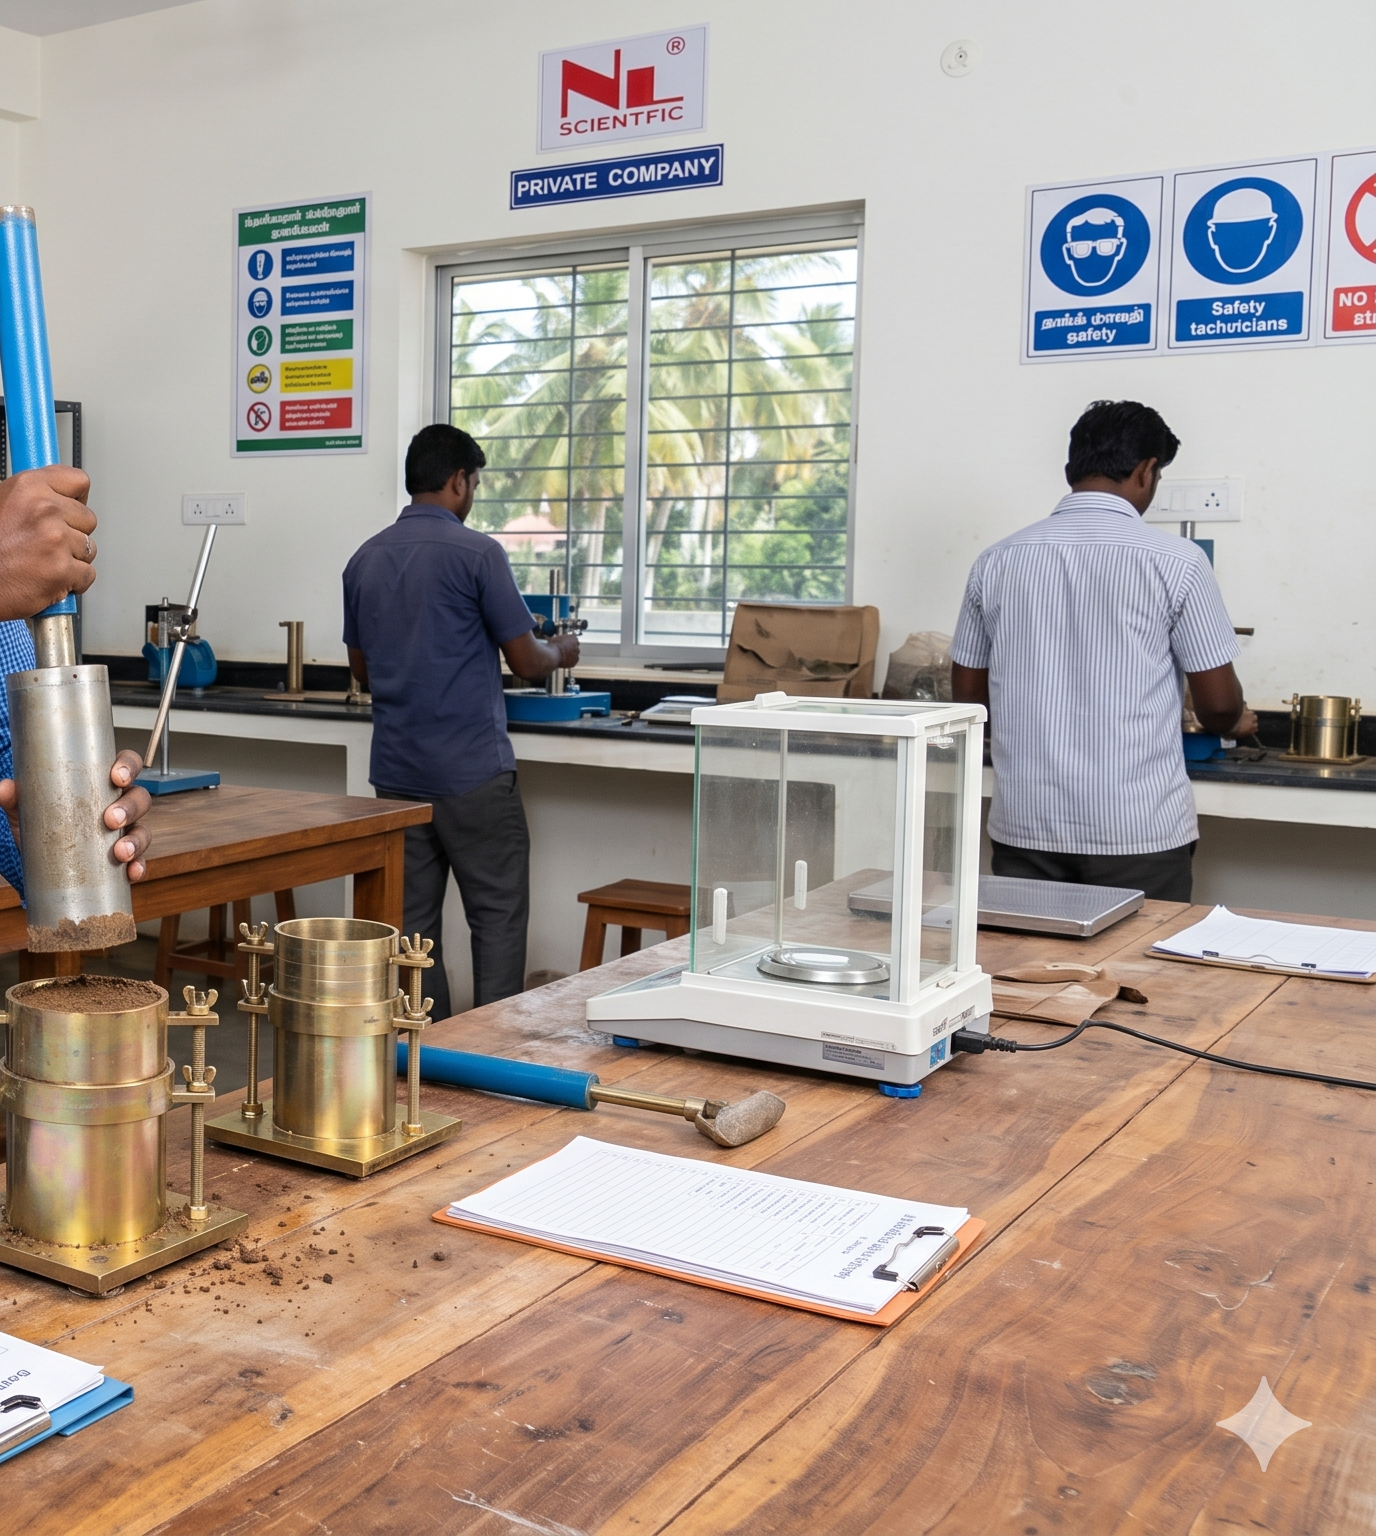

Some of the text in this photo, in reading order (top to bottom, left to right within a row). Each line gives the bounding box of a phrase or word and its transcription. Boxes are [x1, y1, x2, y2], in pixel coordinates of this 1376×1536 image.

[560, 48, 684, 119] NL
[559, 105, 684, 136] SCIENTFIC
[517, 156, 716, 198] PRIVATE COMPANY
[1211, 300, 1266, 316] Safety
[1338, 291, 1368, 307] NO
